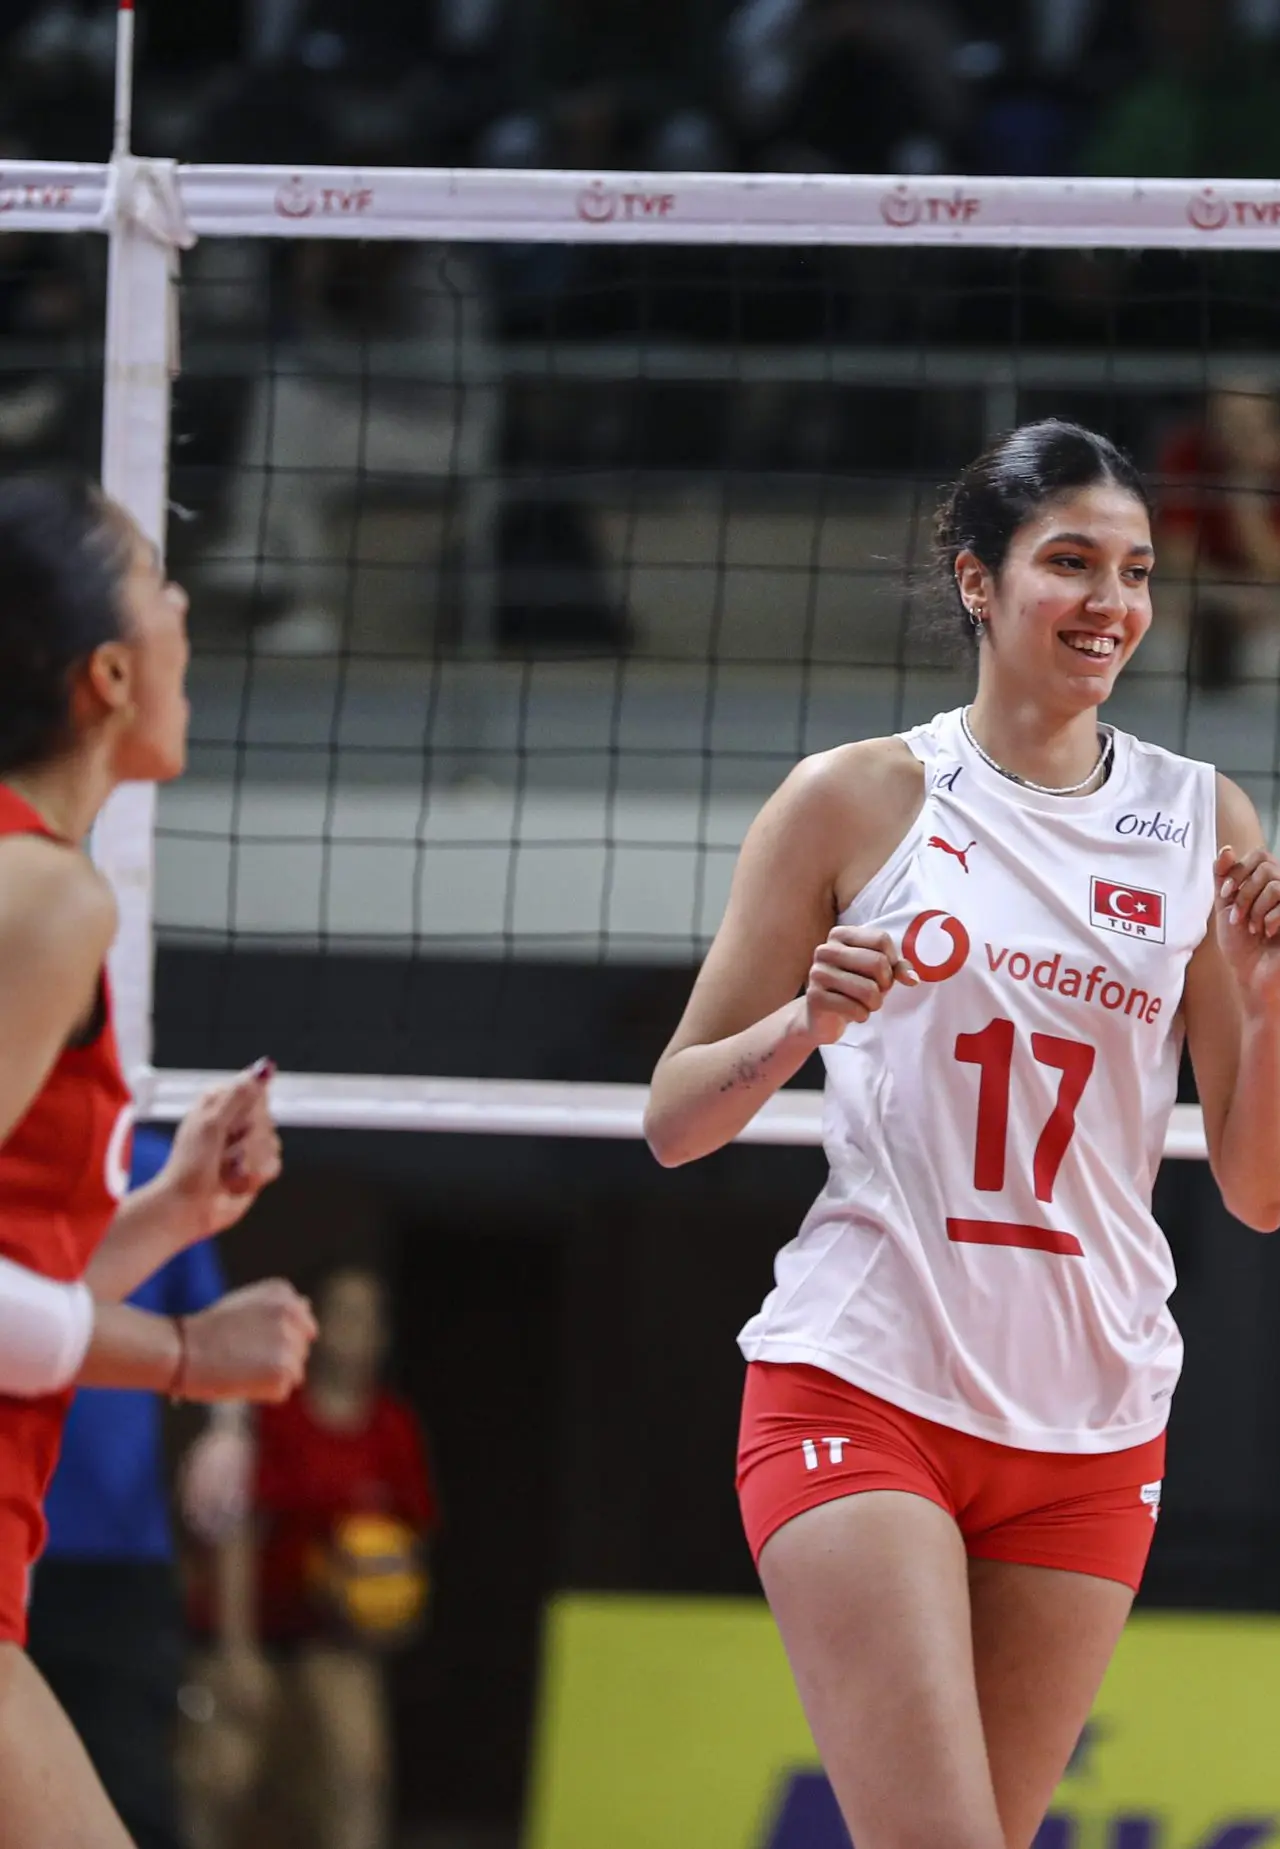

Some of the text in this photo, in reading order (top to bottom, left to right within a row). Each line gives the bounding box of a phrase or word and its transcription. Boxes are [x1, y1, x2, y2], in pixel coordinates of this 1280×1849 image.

[320, 188, 374, 214] TVF
[622, 193, 675, 218] TVF
[926, 197, 980, 222] TVF
[1115, 811, 1190, 849] Orkid
[1108, 918, 1147, 936] TUR
[985, 942, 1162, 1025] vodafone
[954, 1017, 1096, 1203] 17
